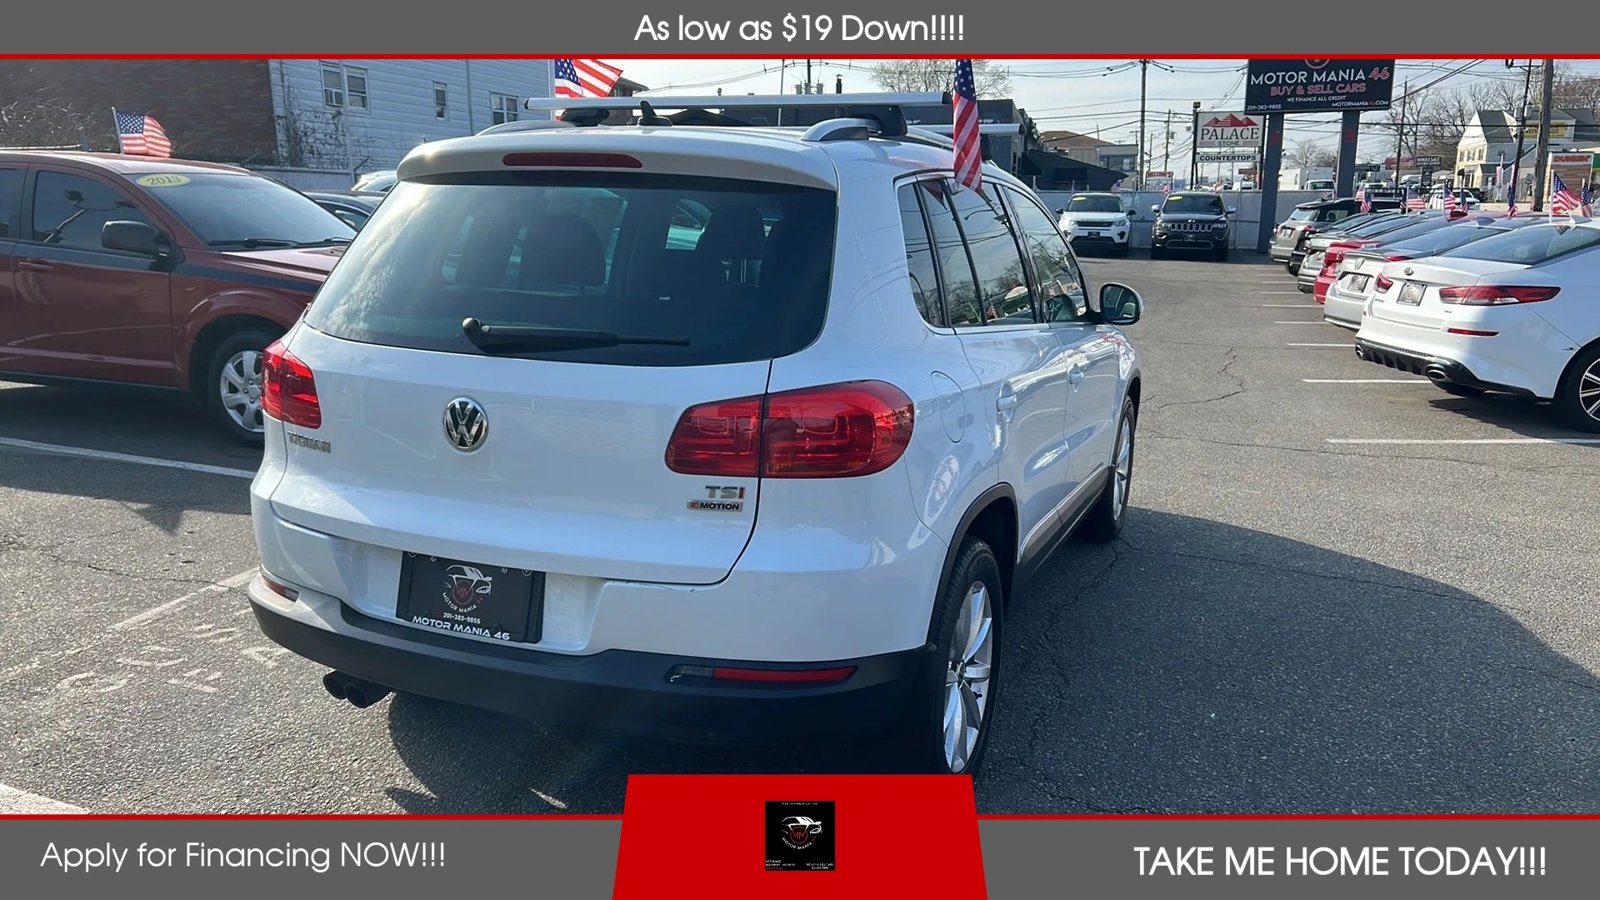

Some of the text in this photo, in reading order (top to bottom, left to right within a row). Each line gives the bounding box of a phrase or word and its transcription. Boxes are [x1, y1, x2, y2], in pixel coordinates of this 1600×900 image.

[1251, 67, 1390, 85] MOTOR MANIA 46
[1270, 82, 1367, 97] BUY & SELL CARS
[1200, 127, 1260, 140] PALACE
[147, 176, 182, 185] 2013
[704, 486, 745, 499] TSI
[443, 592, 477, 613] MOTOR MANIA
[412, 615, 510, 640] MOTOR MANIA 46
